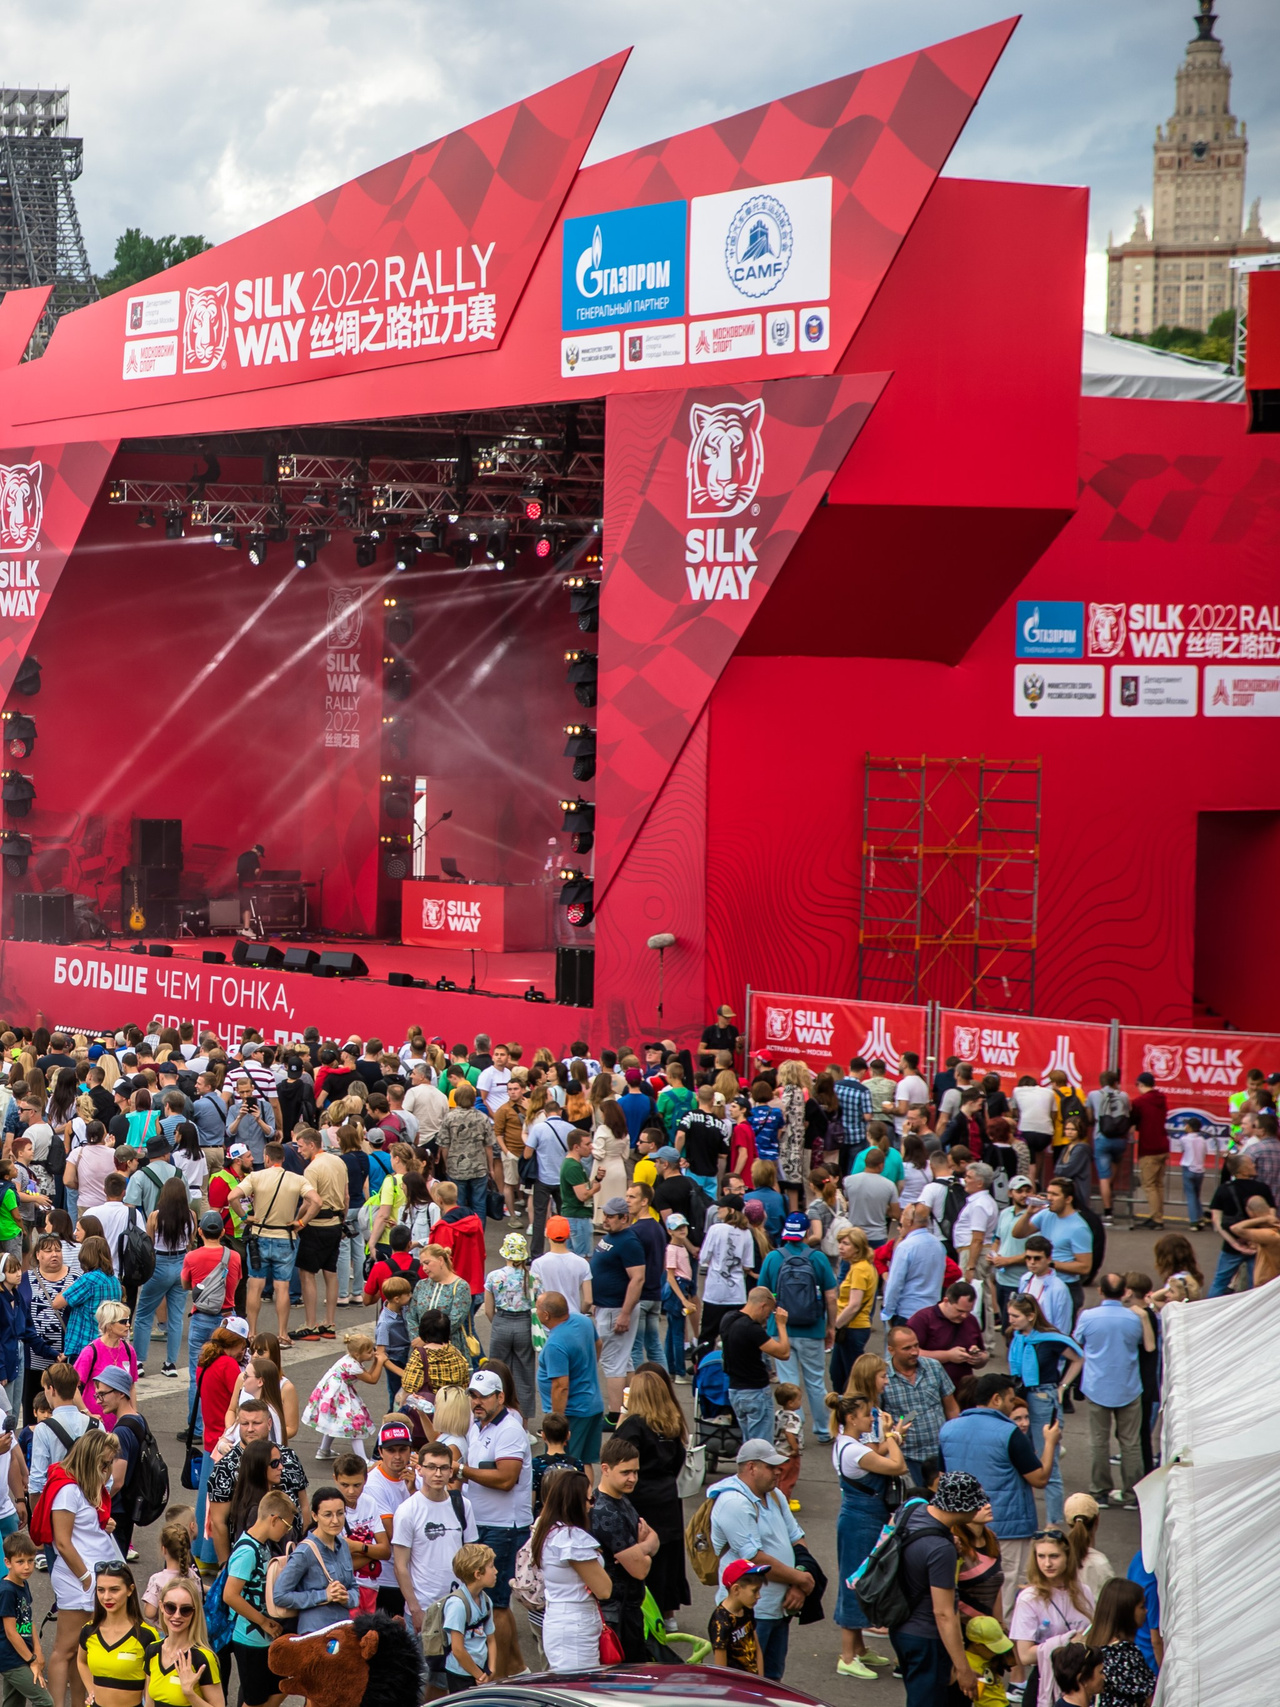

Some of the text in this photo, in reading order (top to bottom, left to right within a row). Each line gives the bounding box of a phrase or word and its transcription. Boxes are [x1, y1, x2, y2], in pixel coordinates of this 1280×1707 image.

[234, 241, 496, 322] SILK 2022 RALLY
[603, 260, 670, 296] ГАЗПРОМ
[734, 262, 782, 281] CAMF
[576, 296, 670, 321] ГЕНЕРАЛЬНЫЙ ПАРТНЕР
[309, 292, 496, 360] 丝绸之路拉力赛
[712, 321, 756, 342] МОСКОВСКИЙ
[234, 318, 303, 368] WAY
[712, 342, 733, 354] СПОРТ
[685, 527, 758, 564] SILK
[685, 565, 758, 600] WAY
[1128, 604, 1185, 630] SILK
[1187, 603, 1238, 631] 2022
[1038, 629, 1077, 643] ГАЗПРОМ
[1128, 632, 1184, 658] WAY
[326, 653, 360, 673] SILK
[326, 674, 361, 692] WAY
[325, 696, 360, 710] RALLY
[325, 711, 360, 732] 2022
[324, 733, 360, 748] 丝绸之路
[447, 900, 481, 917] SILK
[447, 916, 481, 933] WAY
[54, 956, 295, 1019] БОЛЬШЕ ЧЕМ ГОНКА,
[794, 1010, 835, 1030] SILK
[795, 1026, 835, 1046] WAY
[981, 1028, 1020, 1049] SILK
[980, 1047, 1020, 1067] WAY
[1185, 1046, 1244, 1067] SILK
[1185, 1065, 1244, 1086] WAY
